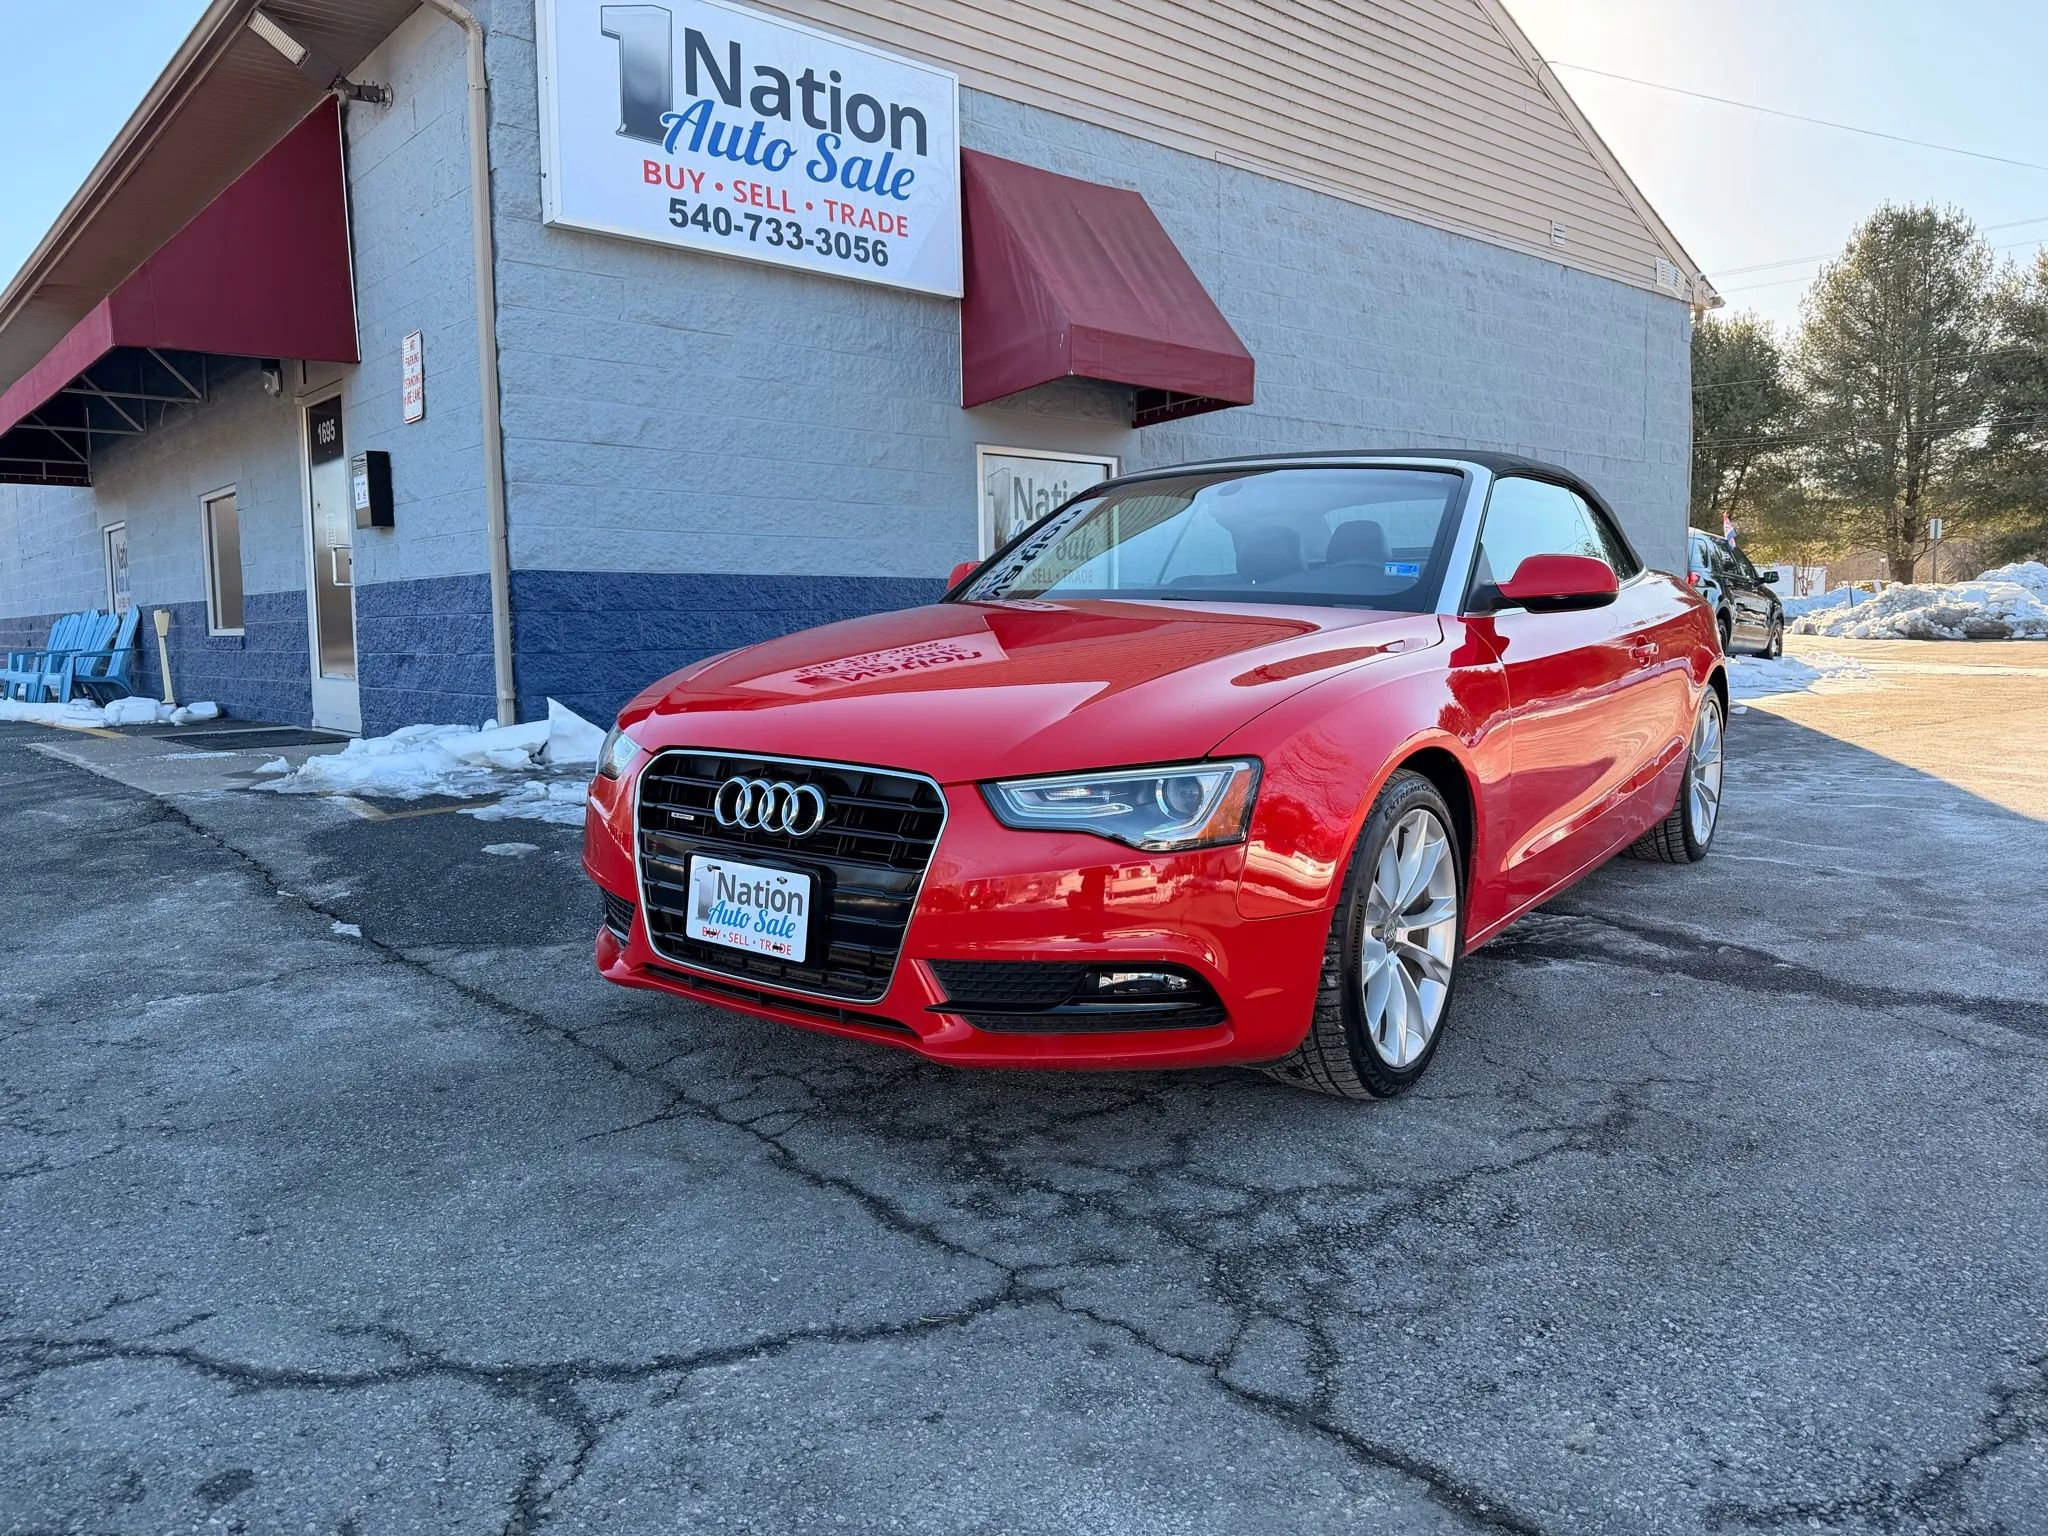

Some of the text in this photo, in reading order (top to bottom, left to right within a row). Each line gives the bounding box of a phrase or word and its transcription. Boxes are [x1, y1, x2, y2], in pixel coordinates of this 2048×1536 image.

[600, 4, 928, 157] 1 Nation
[661, 98, 916, 201] Auto Sale
[643, 159, 909, 238] BUY SELL TRADE
[668, 197, 889, 267] 540-733-3056
[318, 418, 336, 445] 1695
[708, 900, 796, 939] Auto Sale
[717, 871, 803, 917] Nation
[728, 931, 750, 947] SELL
